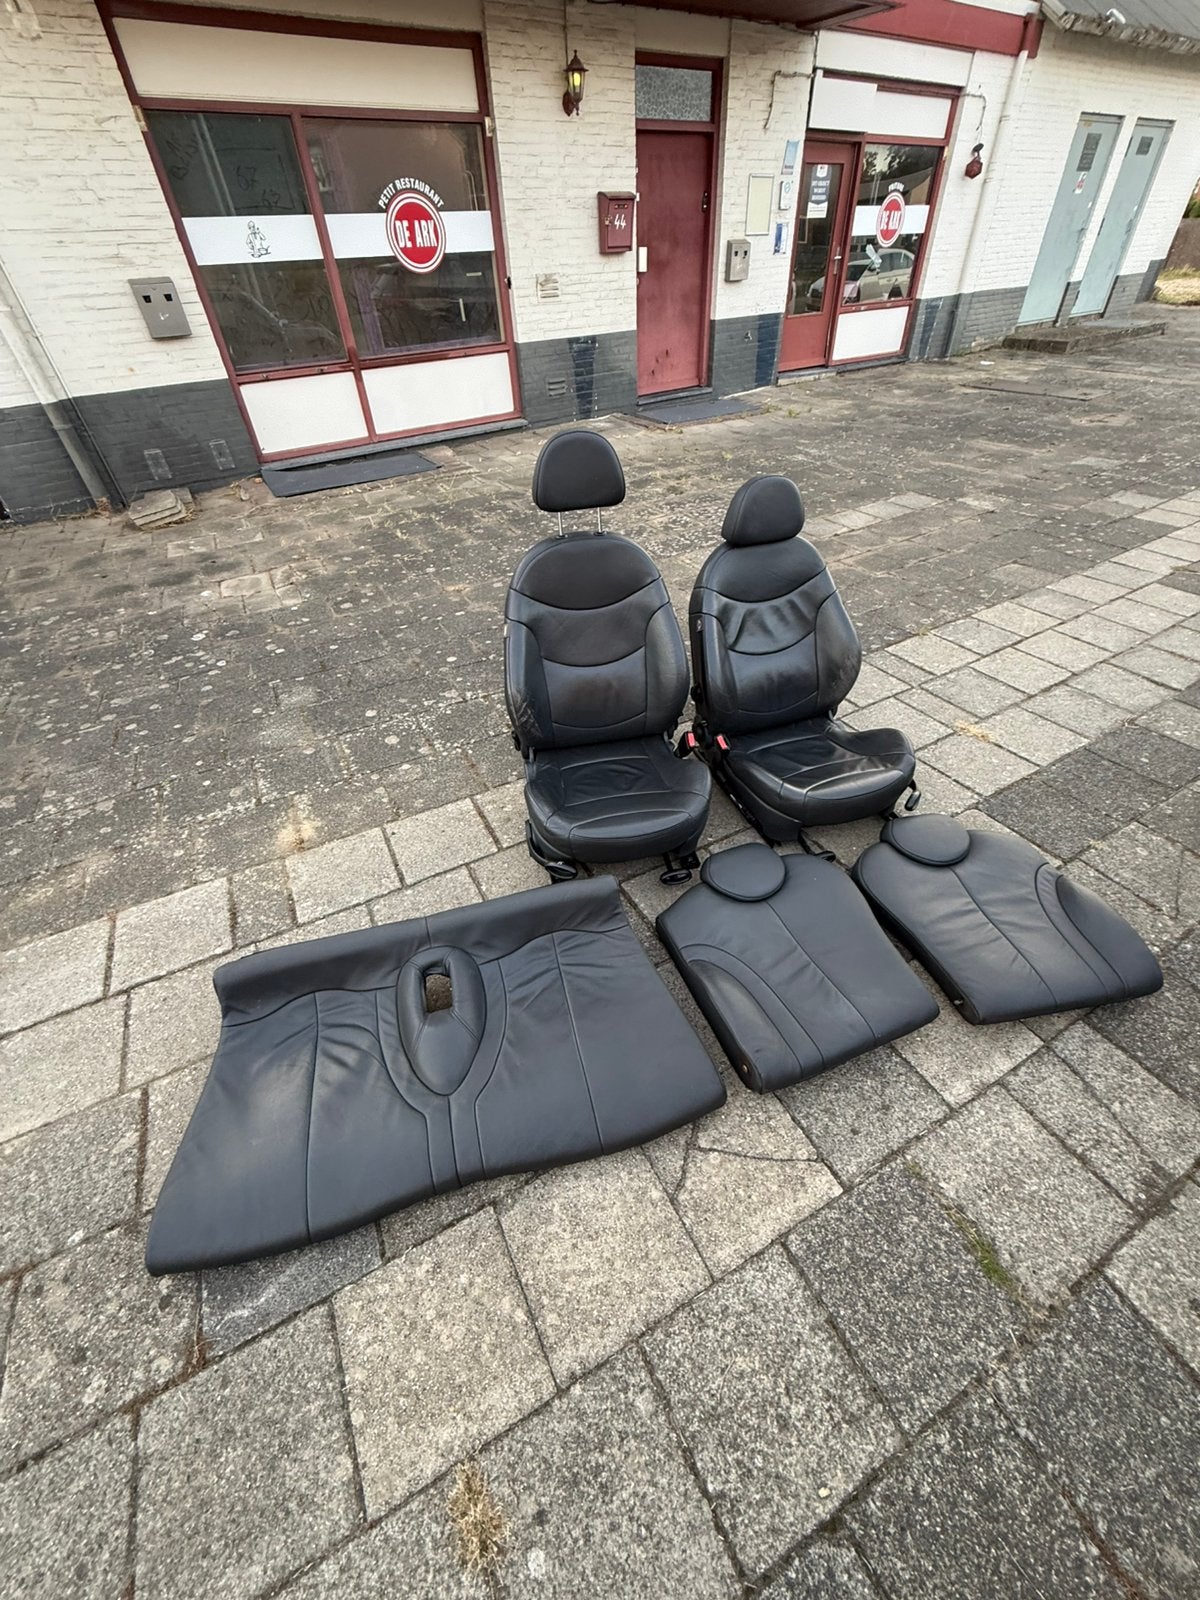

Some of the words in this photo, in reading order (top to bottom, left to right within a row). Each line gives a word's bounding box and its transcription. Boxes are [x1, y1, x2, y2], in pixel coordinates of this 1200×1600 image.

[378, 183, 396, 209] PETIT
[395, 177, 444, 208] RESTAURANT
[395, 220, 412, 248] DE
[414, 220, 438, 248] ARK
[614, 214, 626, 230] 44
